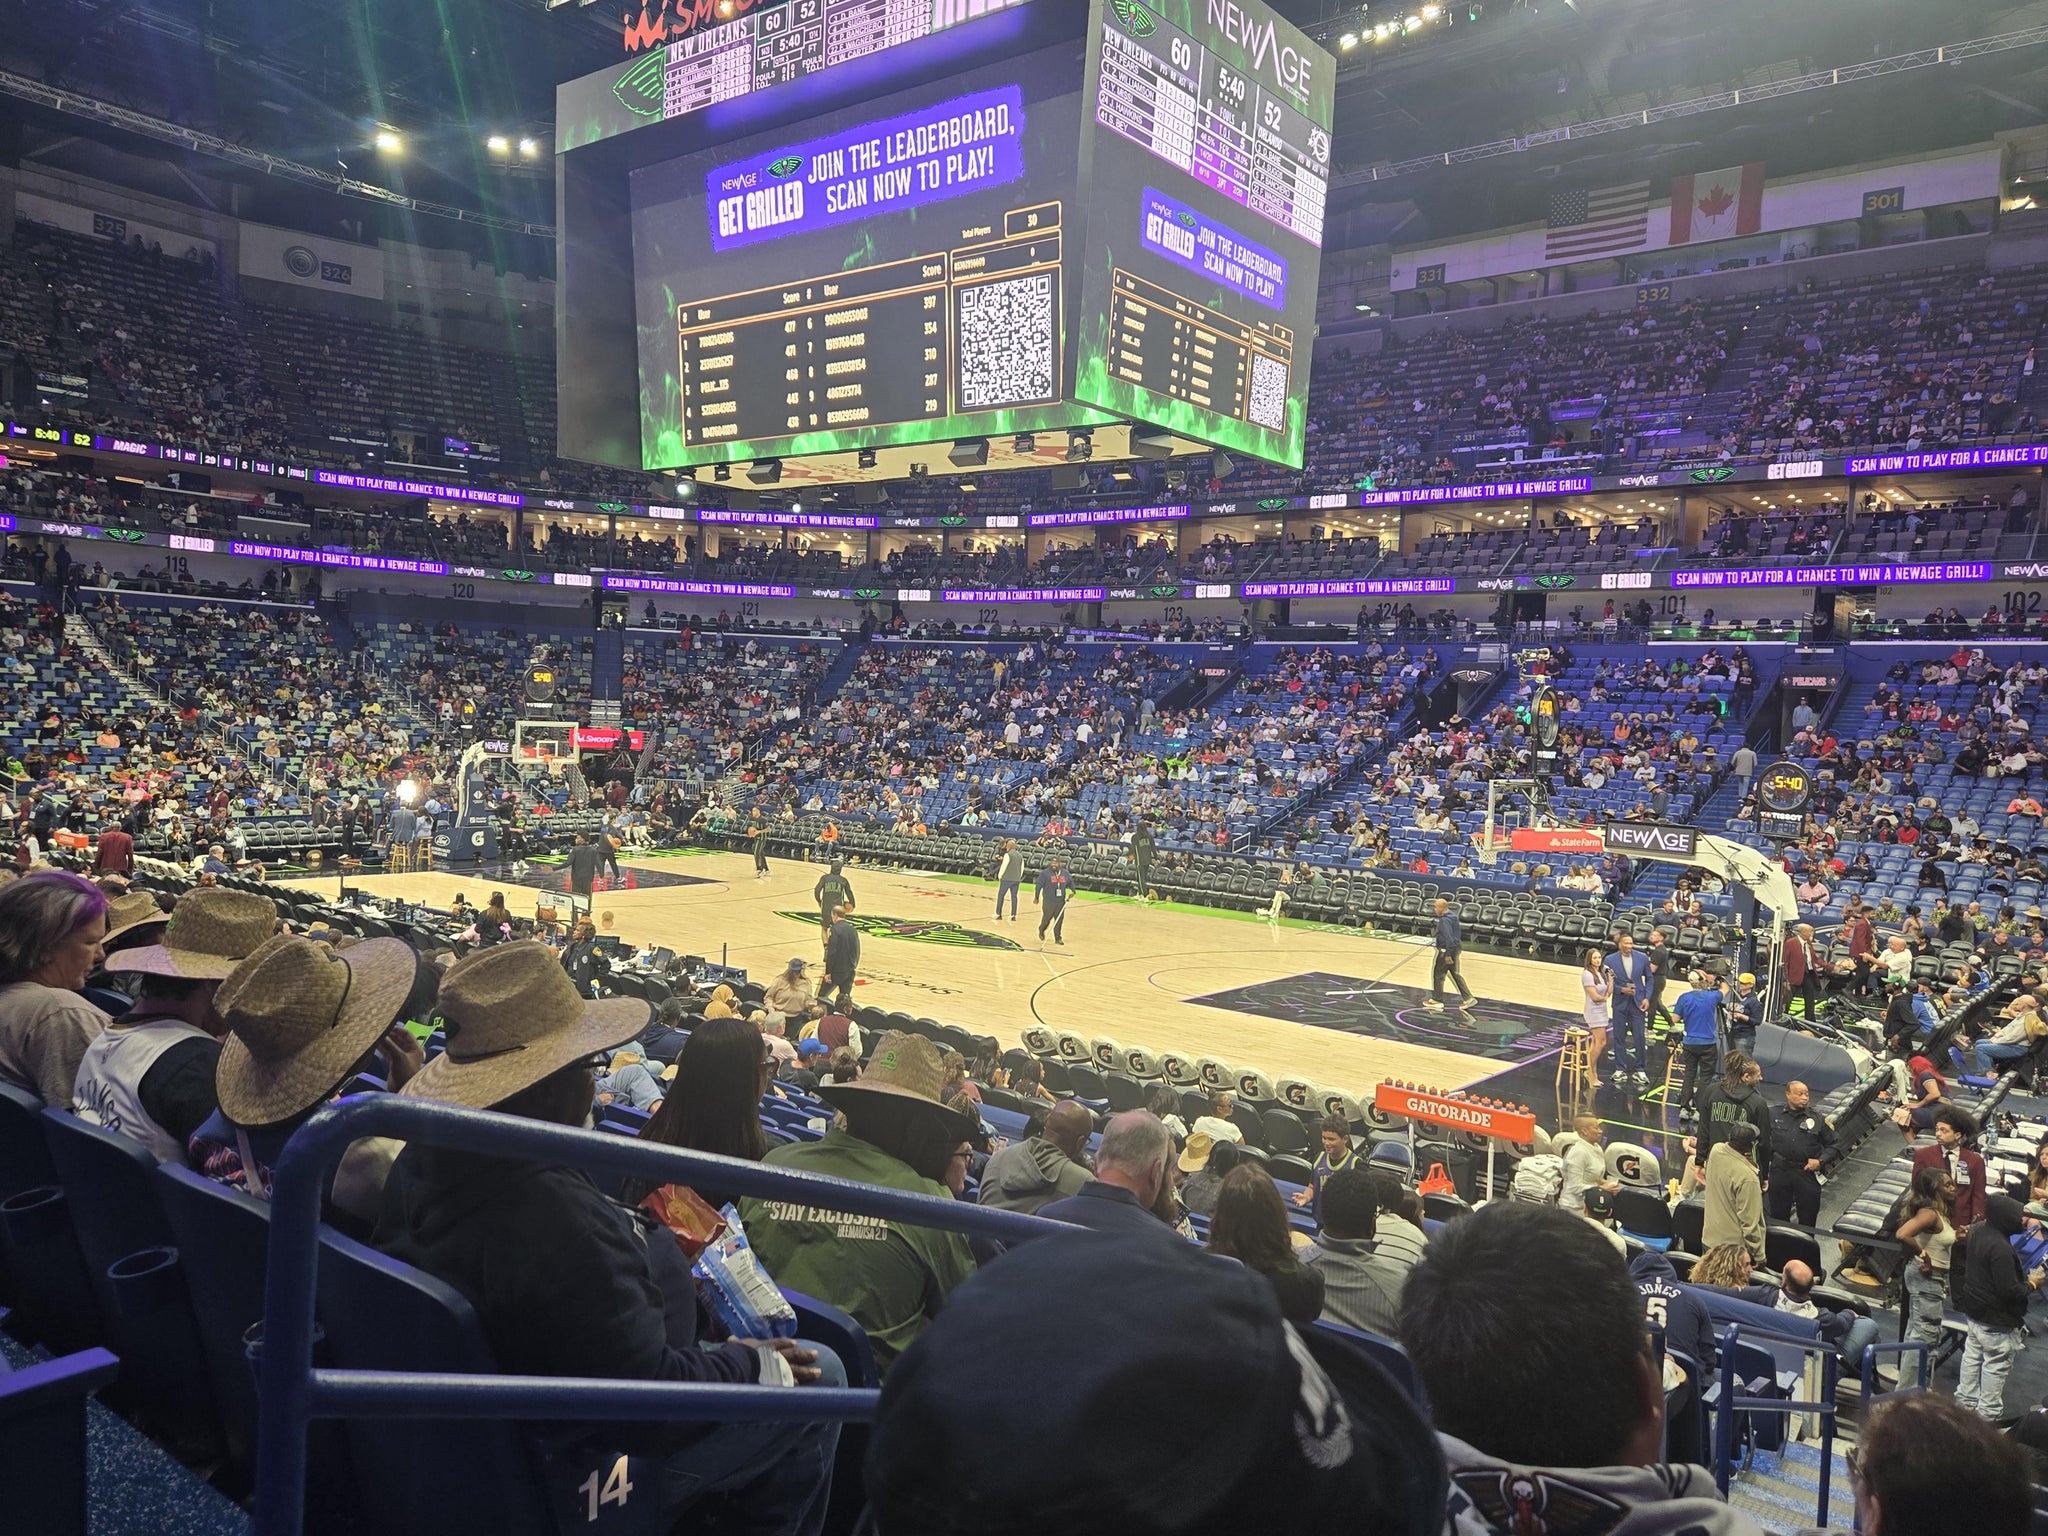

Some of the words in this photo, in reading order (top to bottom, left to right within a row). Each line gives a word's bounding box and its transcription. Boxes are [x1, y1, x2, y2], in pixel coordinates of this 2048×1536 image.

[800, 1, 815, 19] 52
[766, 13, 780, 31] 60
[670, 38, 694, 62] NEW
[699, 19, 747, 55] ORLEANS
[779, 34, 800, 52] 5:40
[808, 43, 817, 53] FT
[1105, 26, 1121, 48] NEW
[1123, 39, 1153, 69] ORLEANS
[802, 55, 822, 68] FOULS
[1171, 37, 1190, 70] 60
[761, 59, 769, 69] FT
[756, 70, 775, 83] FOULS
[1219, 67, 1244, 101] 5:40
[1220, 107, 1235, 125] FOULS
[1265, 100, 1281, 131] 52
[808, 149, 844, 184] JOIN
[848, 139, 881, 173] THE
[886, 104, 1015, 164] LEADERBOARD,
[1258, 126, 1283, 151] ORLANDO
[721, 173, 757, 191] NEWAGE
[826, 179, 868, 214] SCAN
[873, 169, 912, 203] NOW
[917, 159, 940, 192] TO
[947, 145, 994, 184] PLAY!
[718, 195, 743, 237] GET
[746, 180, 804, 231] GRILLED
[1865, 192, 1900, 211] 301
[1027, 213, 1038, 227] 30
[1147, 212, 1163, 244] GET
[1163, 221, 1195, 260] GRILLED
[1197, 226, 1216, 250] JOIN
[1218, 235, 1232, 258] THE
[1234, 243, 1283, 285] LEADERBOARD,
[323, 265, 350, 280] 326
[1204, 251, 1223, 276] SCAN
[1226, 261, 1244, 285] NOW
[1245, 270, 1254, 290] TO
[1255, 276, 1275, 300] PLAY!
[1419, 269, 1442, 283] 331
[697, 309, 711, 321] User
[783, 292, 800, 304] Score
[824, 284, 839, 296] User
[923, 265, 942, 278] Score
[1638, 286, 1670, 303] 332
[924, 295, 936, 310] 397
[924, 321, 937, 335] 354
[924, 347, 937, 361] 310
[924, 372, 938, 387] 287
[925, 398, 938, 412] 219
[35, 428, 60, 440] 5:40
[74, 433, 90, 446] 52
[113, 440, 147, 454] MAGIC
[166, 449, 177, 458] 15
[184, 452, 196, 462] AST
[205, 455, 216, 464] 29
[242, 461, 248, 470] 5
[278, 466, 284, 474] 0
[1851, 458, 1876, 472] SCAN
[1879, 456, 1903, 470] NOW
[1906, 455, 1919, 468] TO
[1922, 453, 1948, 466] PLAY
[1950, 452, 1970, 465] FOR
[1973, 451, 1979, 463] A
[1984, 447, 2028, 463] CHANCE
[2032, 446, 2047, 460] TO
[1768, 464, 1785, 479] GET
[1786, 461, 1823, 478] GRILLED
[1620, 475, 1659, 486] NEWAGE
[1365, 492, 1383, 503] SCAN
[1384, 491, 1400, 502] NOW
[1401, 490, 1411, 501] TO
[1412, 489, 1429, 500] PLAY
[1430, 488, 1443, 499] FOR
[1445, 487, 1450, 498] A
[1452, 485, 1482, 498] CHANCE
[1484, 484, 1494, 496] TO
[1497, 483, 1513, 494] WIN
[1515, 482, 1520, 493] A
[1523, 480, 1556, 493] NEWAGE
[1559, 478, 1586, 491] GRILL!
[544, 500, 574, 510] NEWAGE
[42, 522, 82, 536] NEWAGE
[164, 556, 187, 572] 119
[234, 543, 252, 554] SCAN
[254, 545, 271, 556] NOW
[272, 547, 282, 557] TO
[283, 548, 299, 559] PLAY
[301, 550, 313, 561] FOR
[315, 552, 320, 561] A
[322, 553, 348, 564] CHANCE
[350, 556, 360, 566] TO
[362, 557, 377, 567] WIN
[379, 558, 385, 568] A
[387, 559, 417, 571] NEWAGE
[454, 567, 485, 576] NEWAGE
[1601, 574, 1617, 588] GET
[1617, 572, 1651, 588] GRILLED
[1676, 572, 1699, 584] SCAN
[1701, 572, 1723, 584] NOW
[1725, 571, 1738, 583] TO
[1740, 570, 1763, 583] PLAY
[1765, 570, 1783, 582] FOR
[1786, 569, 1792, 582] A
[1796, 568, 1836, 582] CHANCE
[1839, 568, 1854, 581] TO
[1858, 568, 1880, 580] WIN
[1884, 567, 1890, 580] A
[1895, 566, 1942, 579] NEWAGE
[1946, 564, 1983, 578] GRILL!
[452, 583, 474, 598] 120
[1478, 579, 1514, 590] NEWAGE
[742, 602, 759, 616] 121
[1379, 603, 1399, 619] 124
[1659, 595, 1687, 615] 101
[2004, 591, 2042, 613] 102
[979, 608, 998, 624] 122
[1164, 607, 1183, 622] 123
[1792, 677, 1826, 686] PELICANS
[1775, 776, 1803, 790] 5:40
[1772, 812, 1802, 822] TISSOT
[471, 831, 485, 846] G
[1610, 828, 1689, 851] NEWAGE
[824, 882, 842, 894] NOLA
[1026, 1030, 1045, 1050] G
[1059, 1037, 1075, 1057] G
[1097, 1045, 1112, 1064] G
[1128, 1052, 1145, 1073] G
[1164, 1058, 1183, 1078] G
[1202, 1063, 1220, 1084] G
[1240, 1075, 1257, 1097] G
[1285, 1084, 1306, 1105] G
[1406, 1097, 1491, 1128] GATORADE
[1711, 1102, 1747, 1123] NOLA
[1615, 1154, 1640, 1180] G
[1639, 1282, 1682, 1299] JONES
[1646, 1297, 1667, 1330] 5
[578, 1454, 633, 1522] 14
